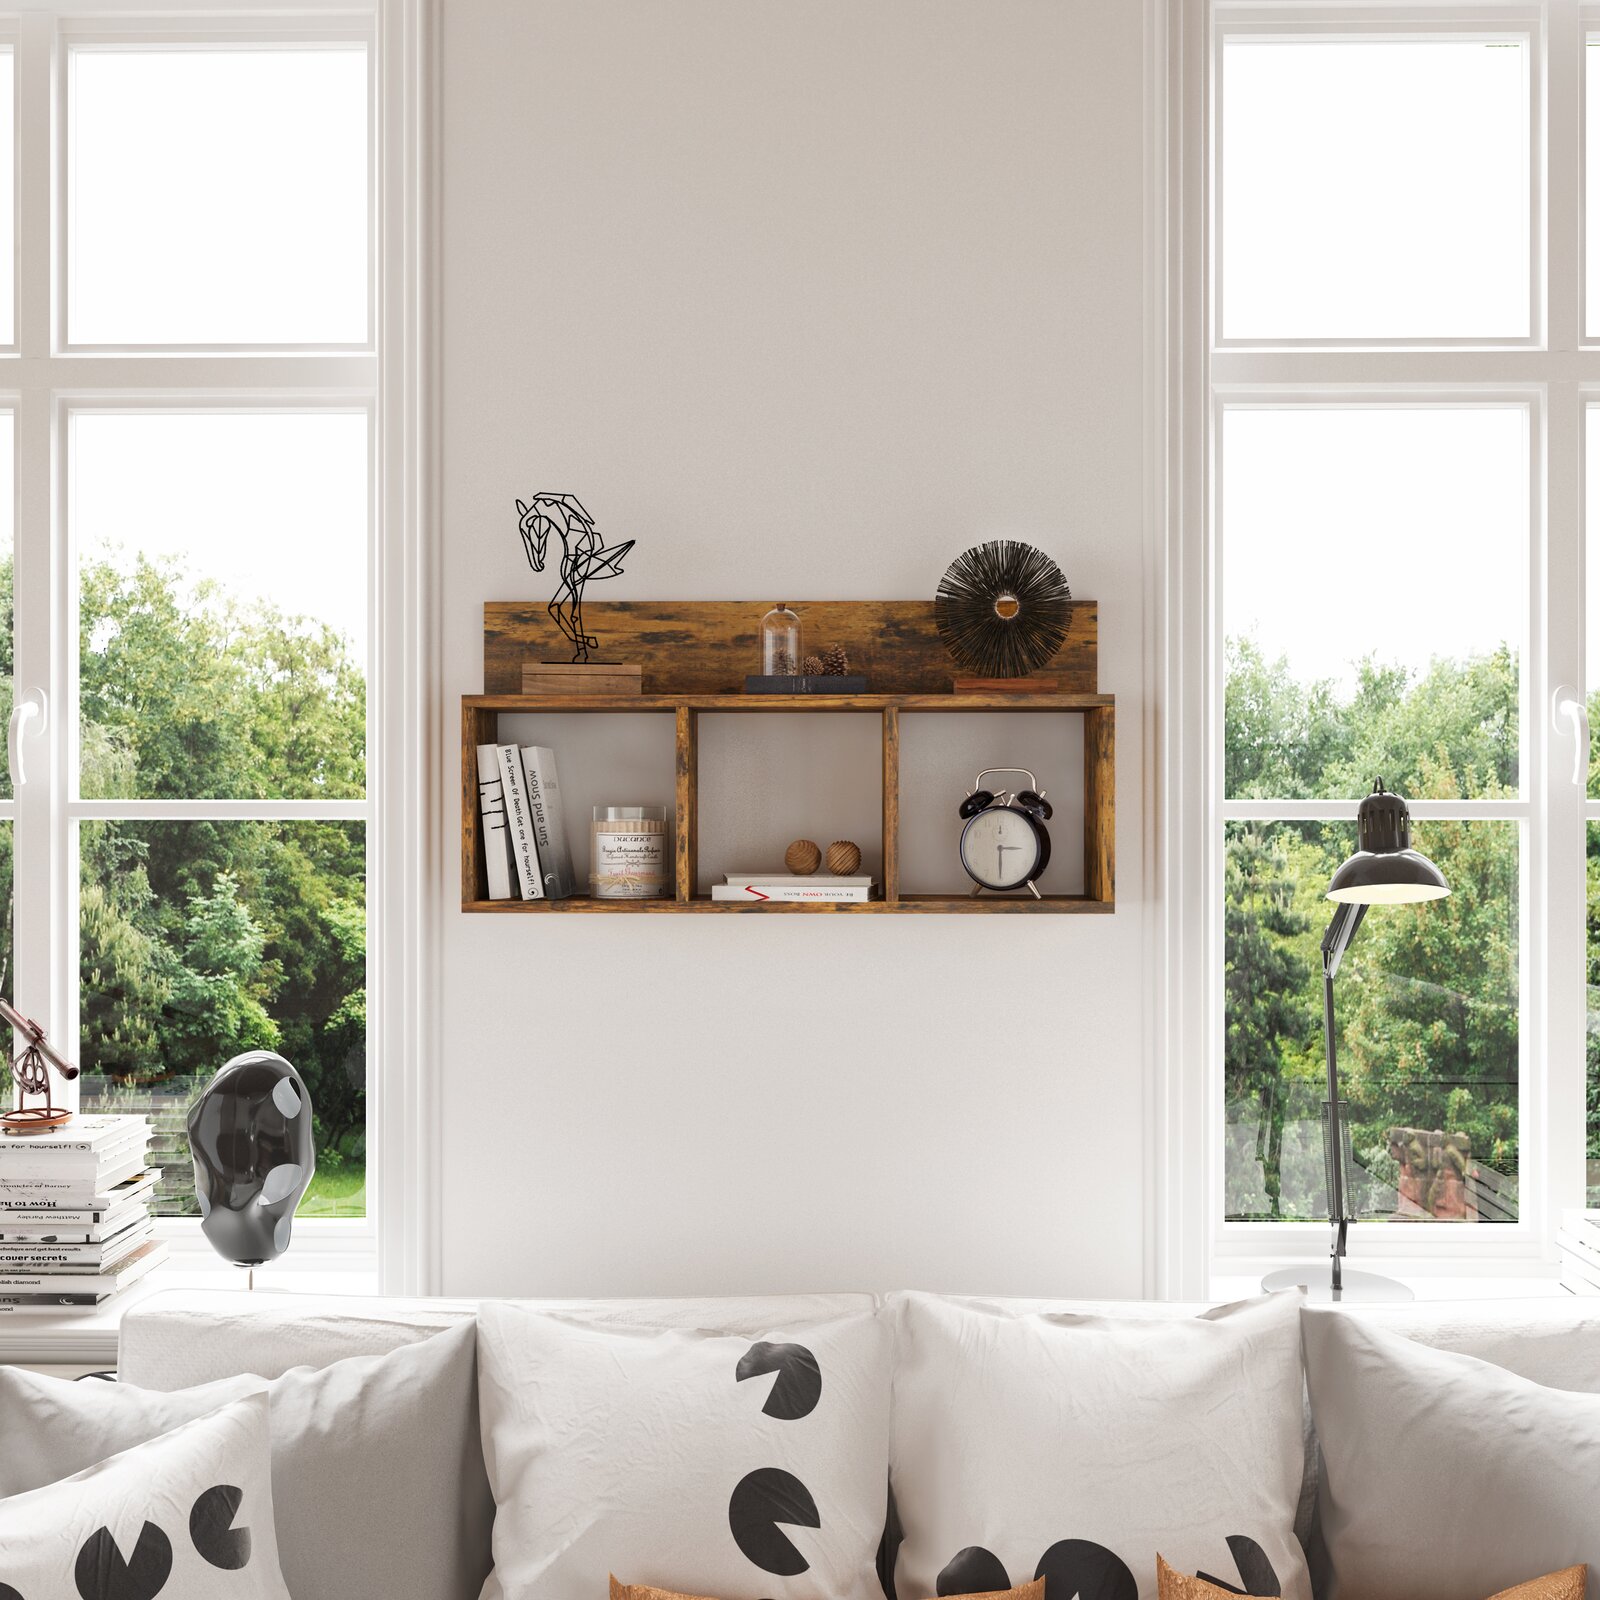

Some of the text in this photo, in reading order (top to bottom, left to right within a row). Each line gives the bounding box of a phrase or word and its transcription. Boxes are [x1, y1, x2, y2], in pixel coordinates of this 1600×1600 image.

[508, 765, 516, 786] Screen
[513, 798, 521, 816] Death
[529, 769, 549, 847] Sun and Snow
[516, 816, 525, 827] Get
